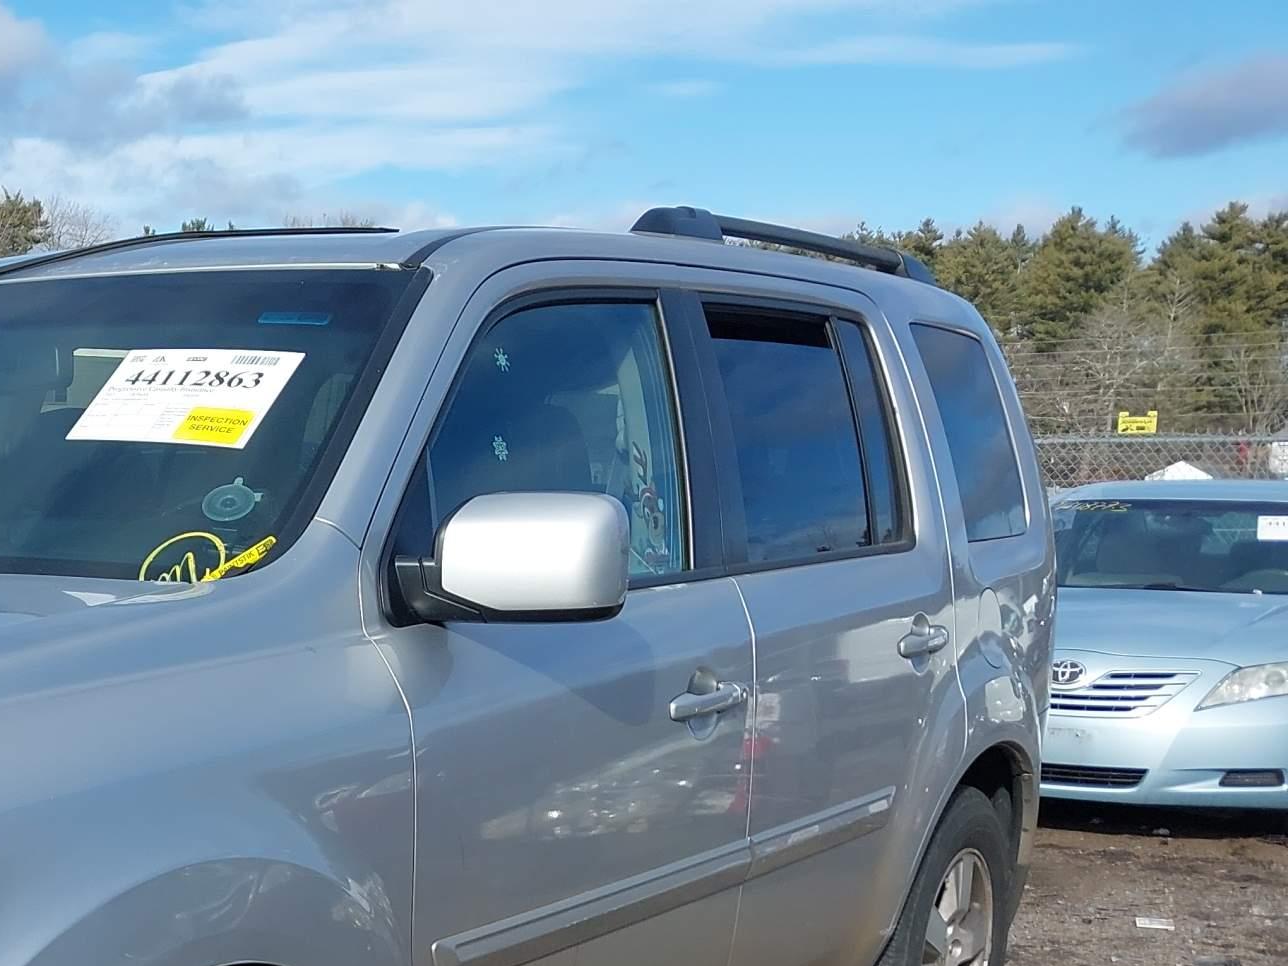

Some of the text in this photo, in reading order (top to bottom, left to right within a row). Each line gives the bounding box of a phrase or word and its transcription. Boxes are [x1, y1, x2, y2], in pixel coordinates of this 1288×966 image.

[125, 369, 265, 388] 44112863
[186, 415, 249, 427] INSPECTION
[188, 423, 236, 434] SERVICE
